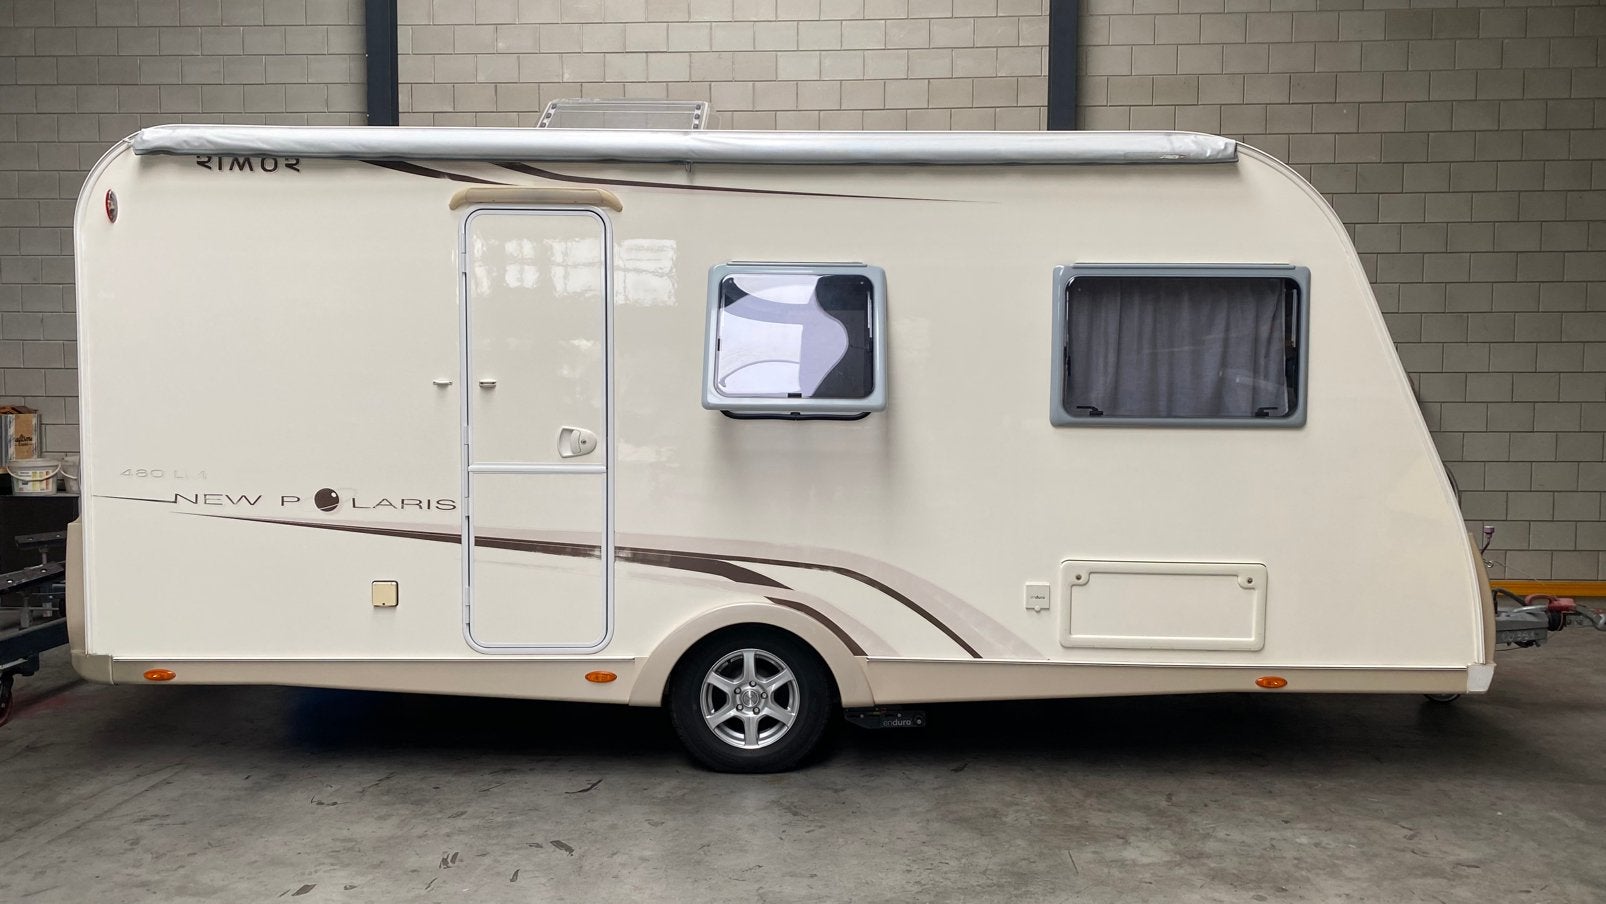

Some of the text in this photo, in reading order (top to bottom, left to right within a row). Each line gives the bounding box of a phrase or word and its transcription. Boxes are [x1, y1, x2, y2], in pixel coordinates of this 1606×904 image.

[196, 155, 300, 173] RIMOR
[120, 468, 165, 478] 480
[174, 493, 263, 506] NEW
[883, 719, 912, 727] enduro
